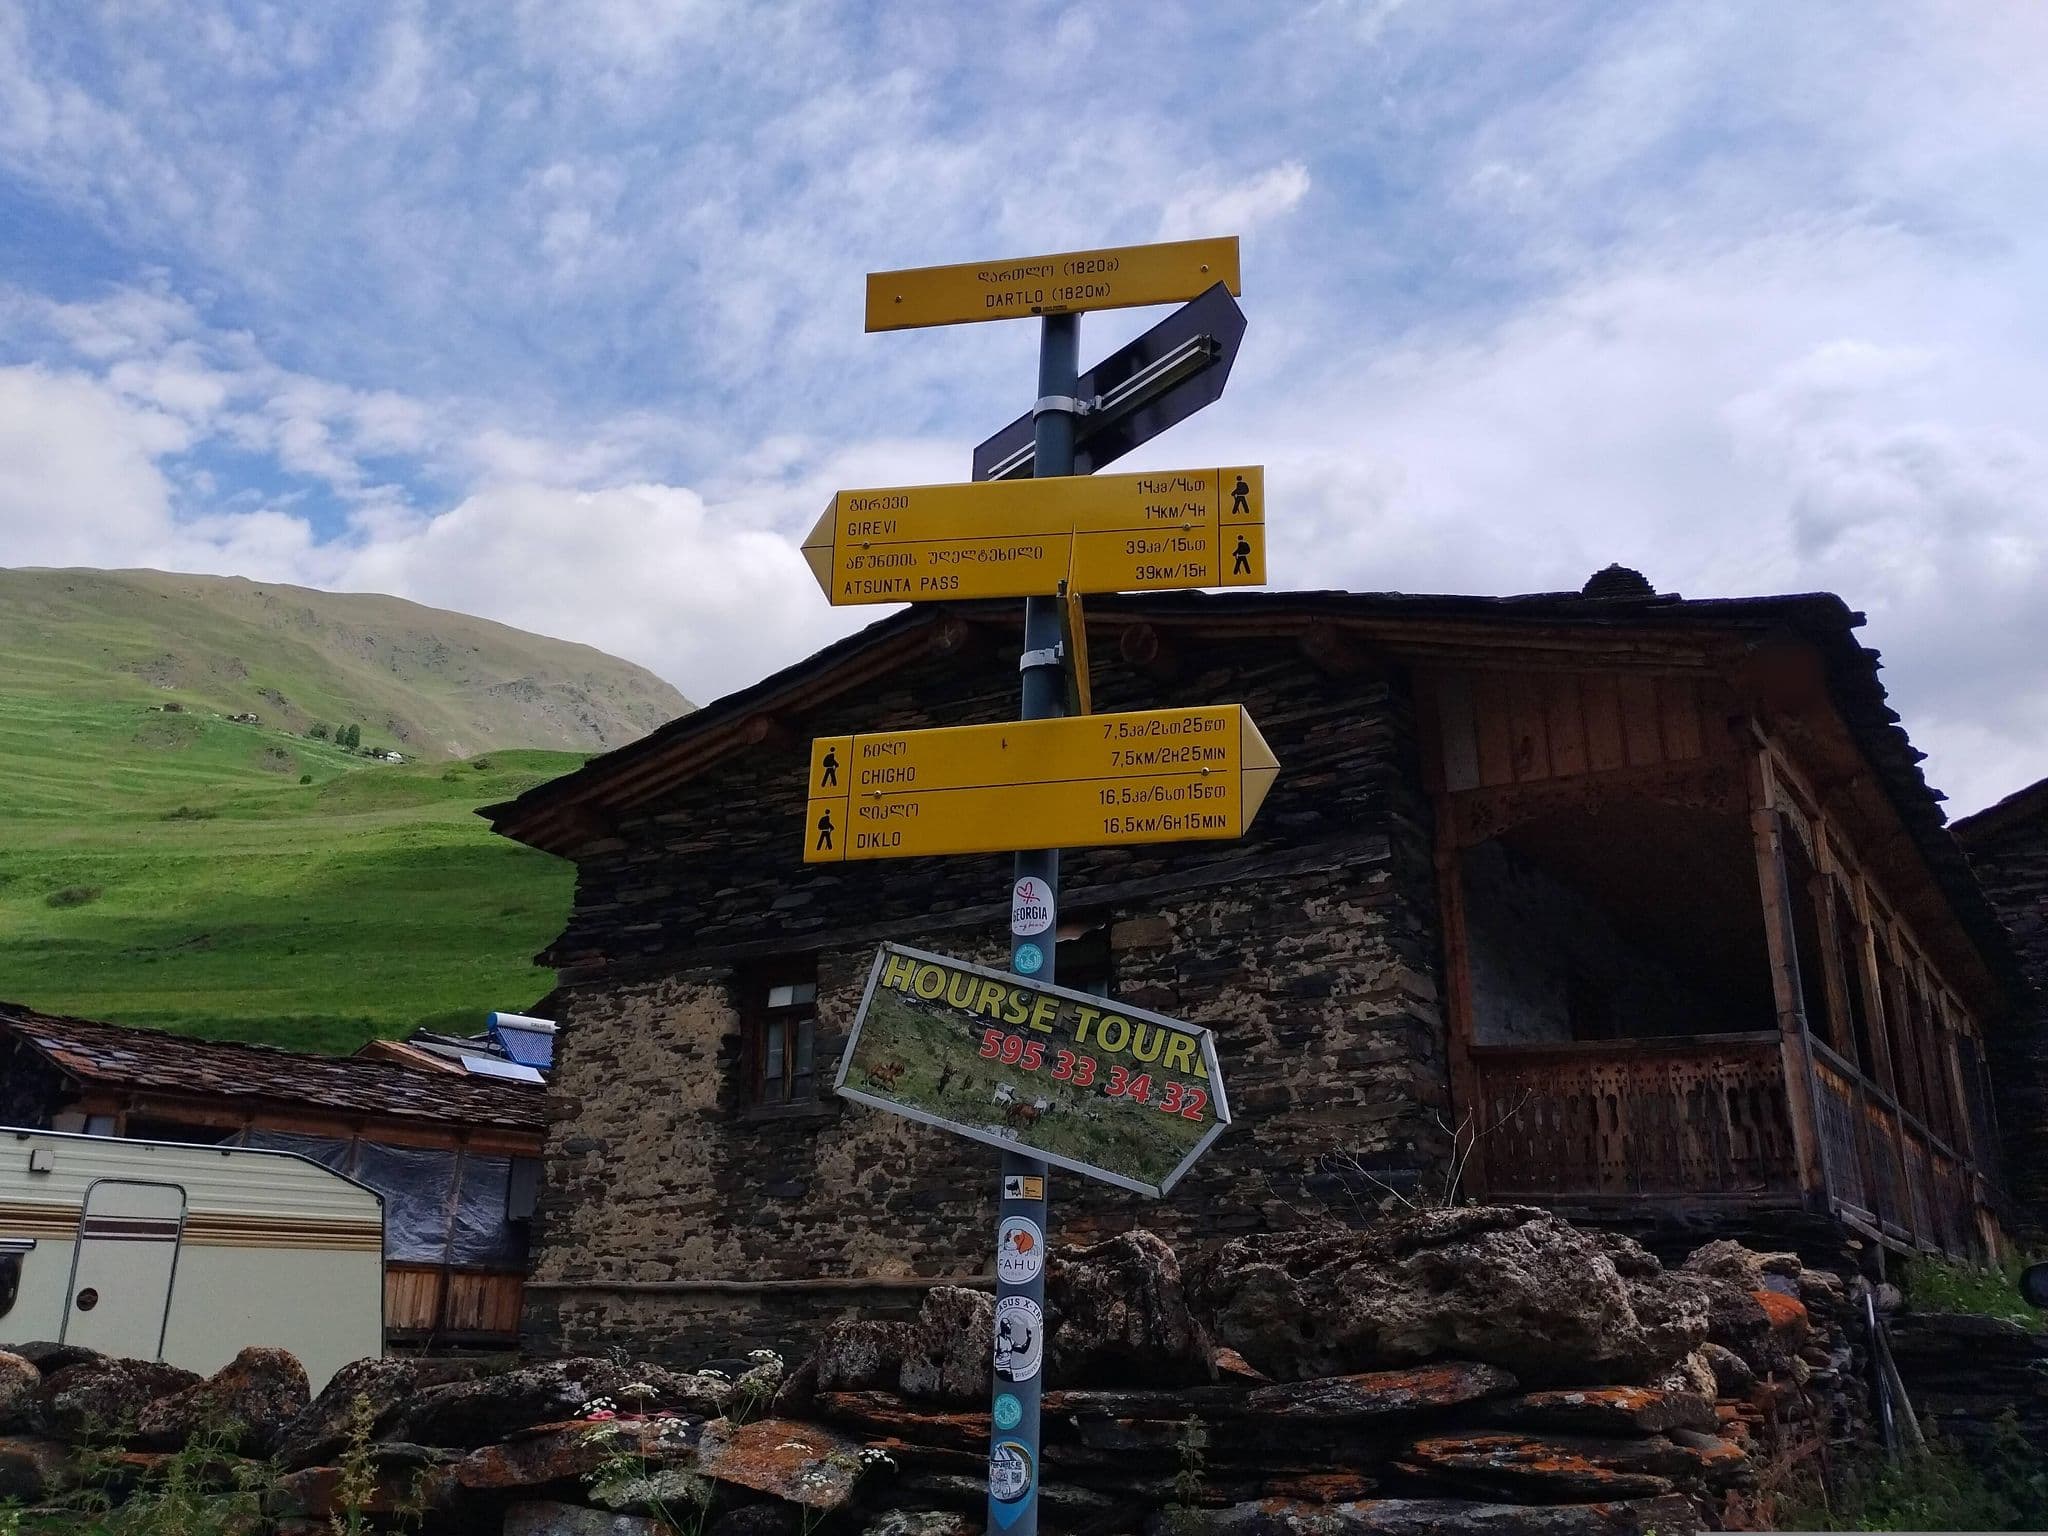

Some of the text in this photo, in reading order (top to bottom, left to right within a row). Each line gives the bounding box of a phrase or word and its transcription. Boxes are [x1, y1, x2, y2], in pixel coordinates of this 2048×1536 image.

[977, 264, 1054, 283] დართლო
[986, 289, 1043, 308] DARTLO
[849, 495, 910, 512] გირევი
[847, 520, 897, 536] GIREVI
[844, 575, 960, 595] ATSUNTA PASS
[861, 766, 916, 785] CHIGHO
[859, 803, 919, 820] დიკლო
[857, 831, 901, 849] DIKLO
[882, 955, 1061, 1035] HOURSE
[978, 1028, 1208, 1123] 595 33 34 32
[997, 1298, 1020, 1315] ASUS
